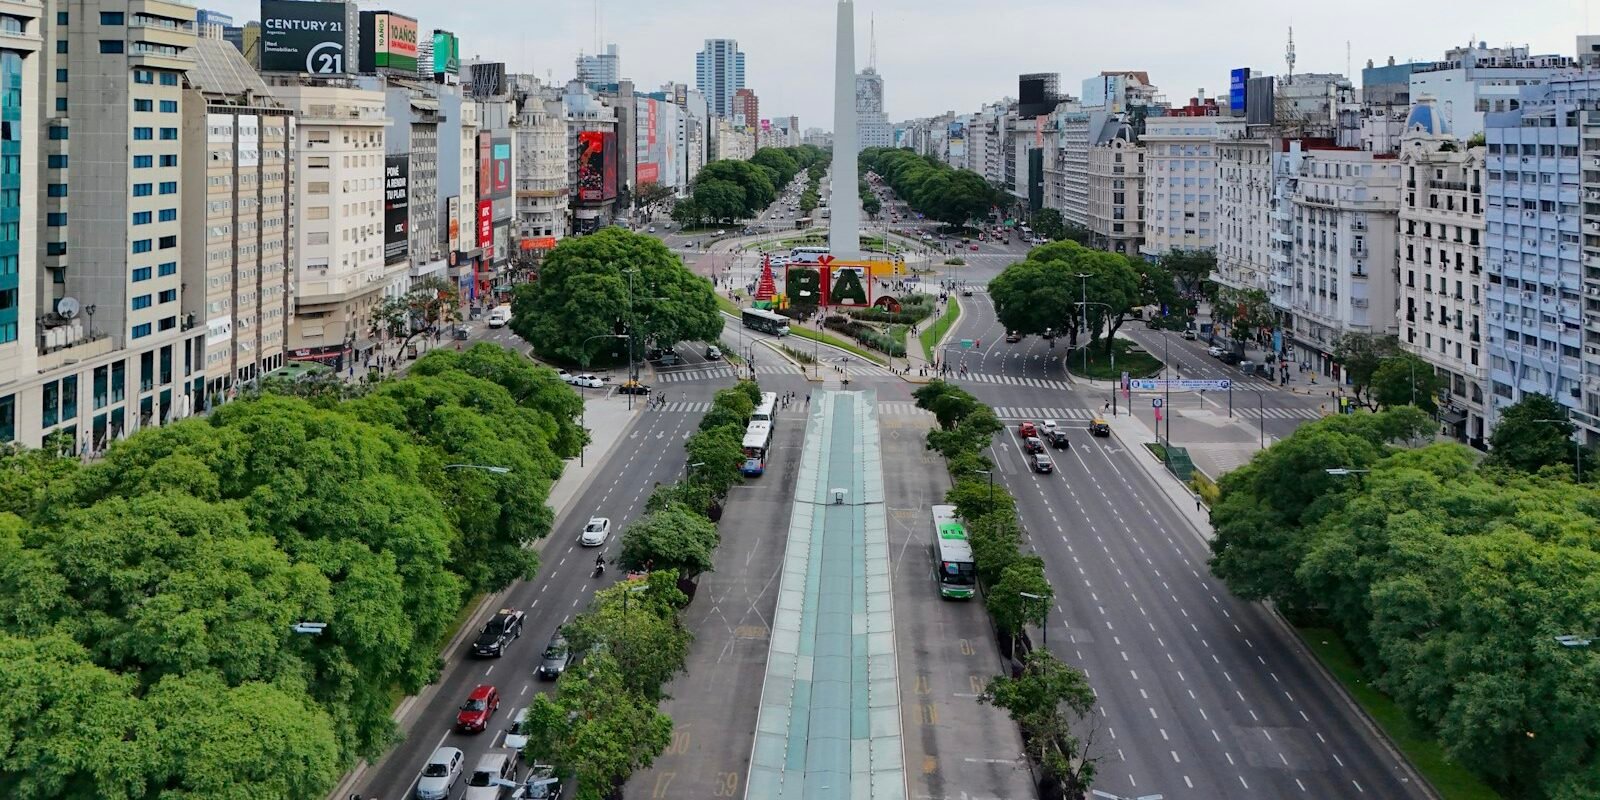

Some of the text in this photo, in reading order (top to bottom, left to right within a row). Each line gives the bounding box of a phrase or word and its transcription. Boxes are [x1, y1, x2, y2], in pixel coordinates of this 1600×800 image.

[265, 19, 328, 31] CENTURY
[391, 25, 416, 43] 10 AÑOS
[387, 165, 399, 176] PONÉ
[387, 179, 390, 188] A
[386, 190, 393, 200] TU
